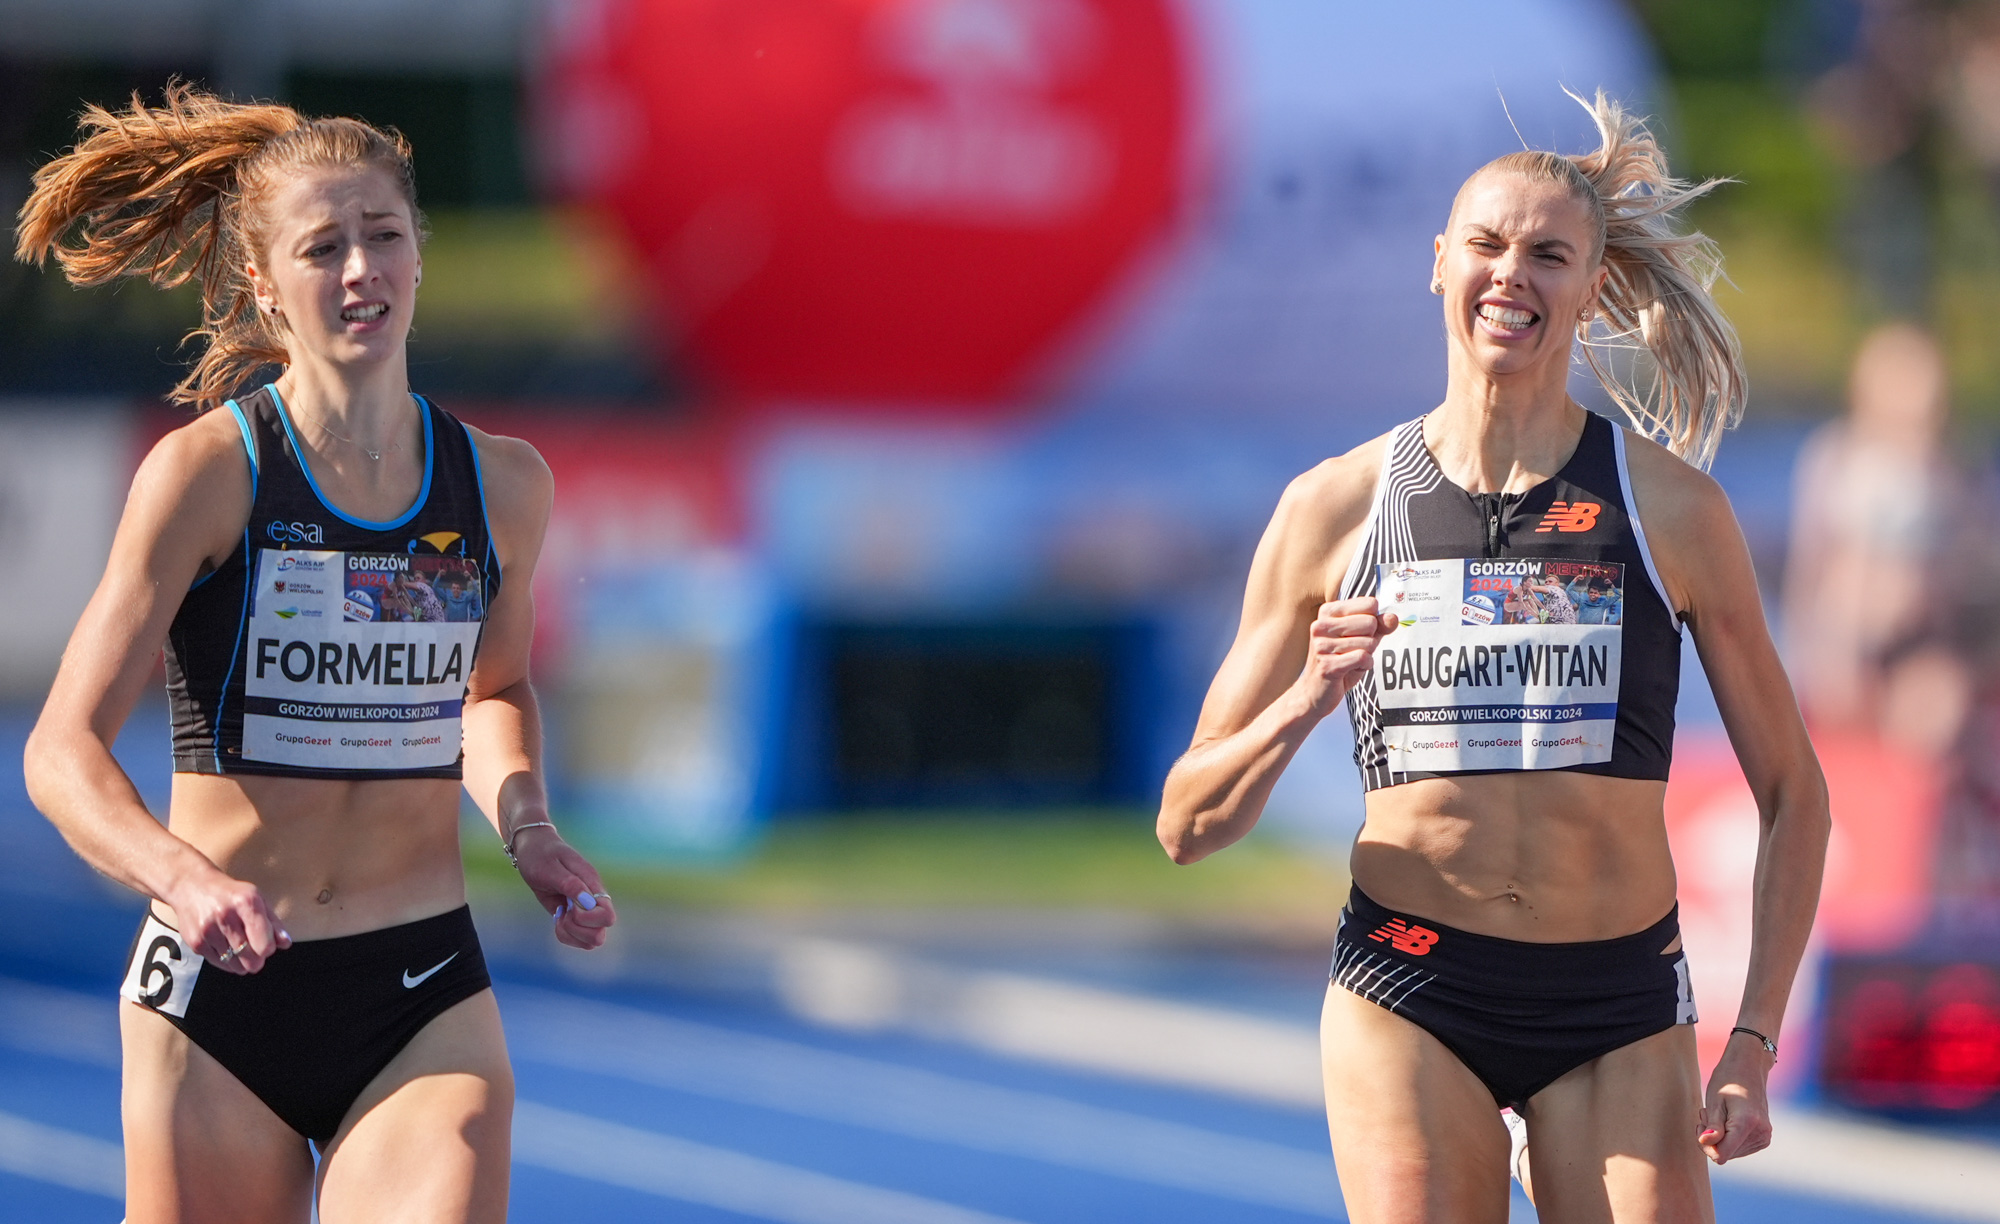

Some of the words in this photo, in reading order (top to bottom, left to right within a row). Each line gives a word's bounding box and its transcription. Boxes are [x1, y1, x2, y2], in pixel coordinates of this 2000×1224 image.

[1535, 501, 1602, 532] NB
[348, 554, 409, 571] GORZÓW
[1469, 559, 1542, 576] GORZÓW
[350, 573, 388, 587] 2024
[1470, 578, 1513, 592] 2024
[256, 638, 462, 685] FORMELLA
[1382, 644, 1608, 690] BAUGART-WITAN
[278, 702, 337, 719] GORZÓW
[337, 706, 420, 720] WIELKOPOLSKI
[420, 705, 440, 718] 2024
[1409, 707, 1460, 722] GORZÓW
[1461, 707, 1552, 721] WIELKOPOLSKI
[1554, 707, 1583, 720] 2024
[275, 732, 332, 746] GrupaGezet
[340, 737, 392, 747] GrupaGezet
[402, 735, 441, 747] GrupaGezet
[1412, 739, 1459, 750] GrupaGezet
[1467, 738, 1522, 748] GrupaGezet
[1531, 735, 1583, 747] GrupaGezet
[1368, 917, 1440, 956] NB
[139, 935, 182, 1008] 6
